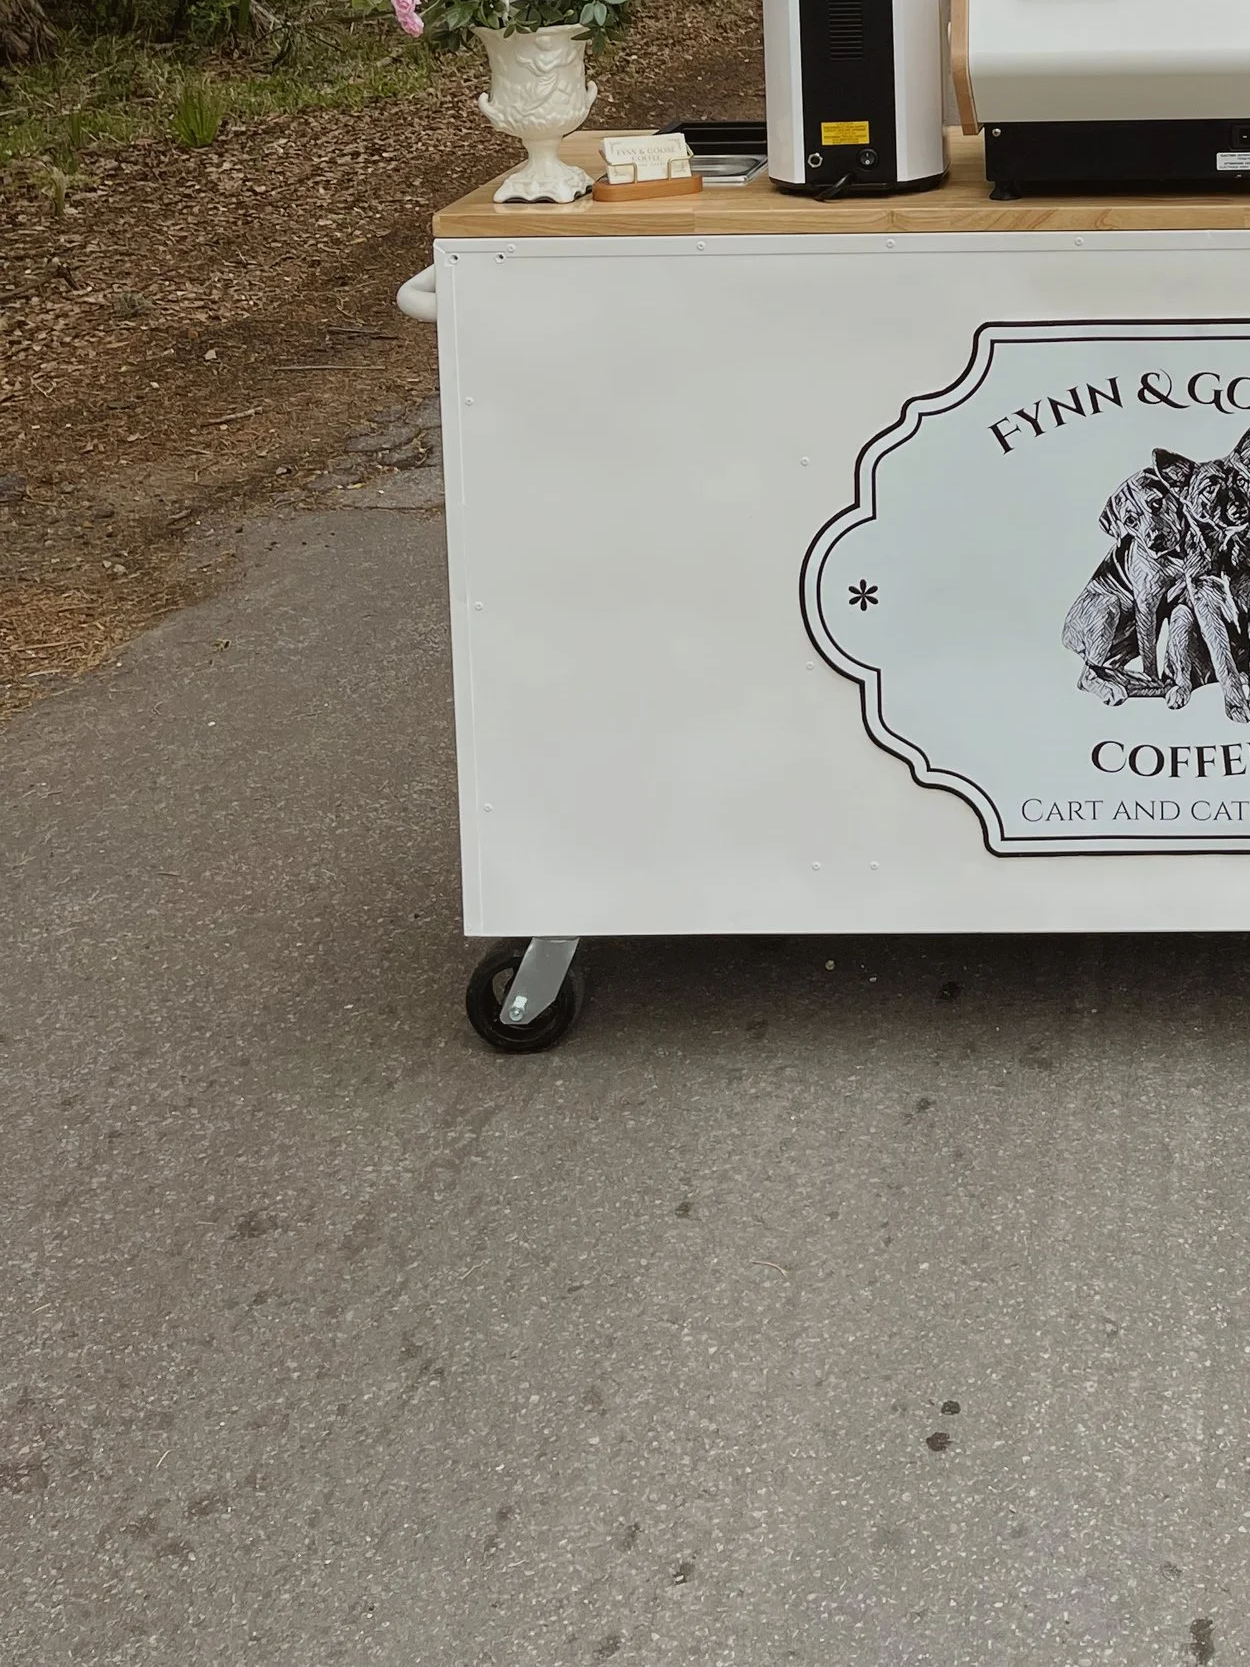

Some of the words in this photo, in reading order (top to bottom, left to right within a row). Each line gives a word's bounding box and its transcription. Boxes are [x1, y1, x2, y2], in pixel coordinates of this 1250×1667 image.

[987, 376, 1124, 455] FYNN
[1136, 368, 1191, 410] &
[1021, 797, 1104, 823] CART
[1113, 799, 1181, 822] AND
